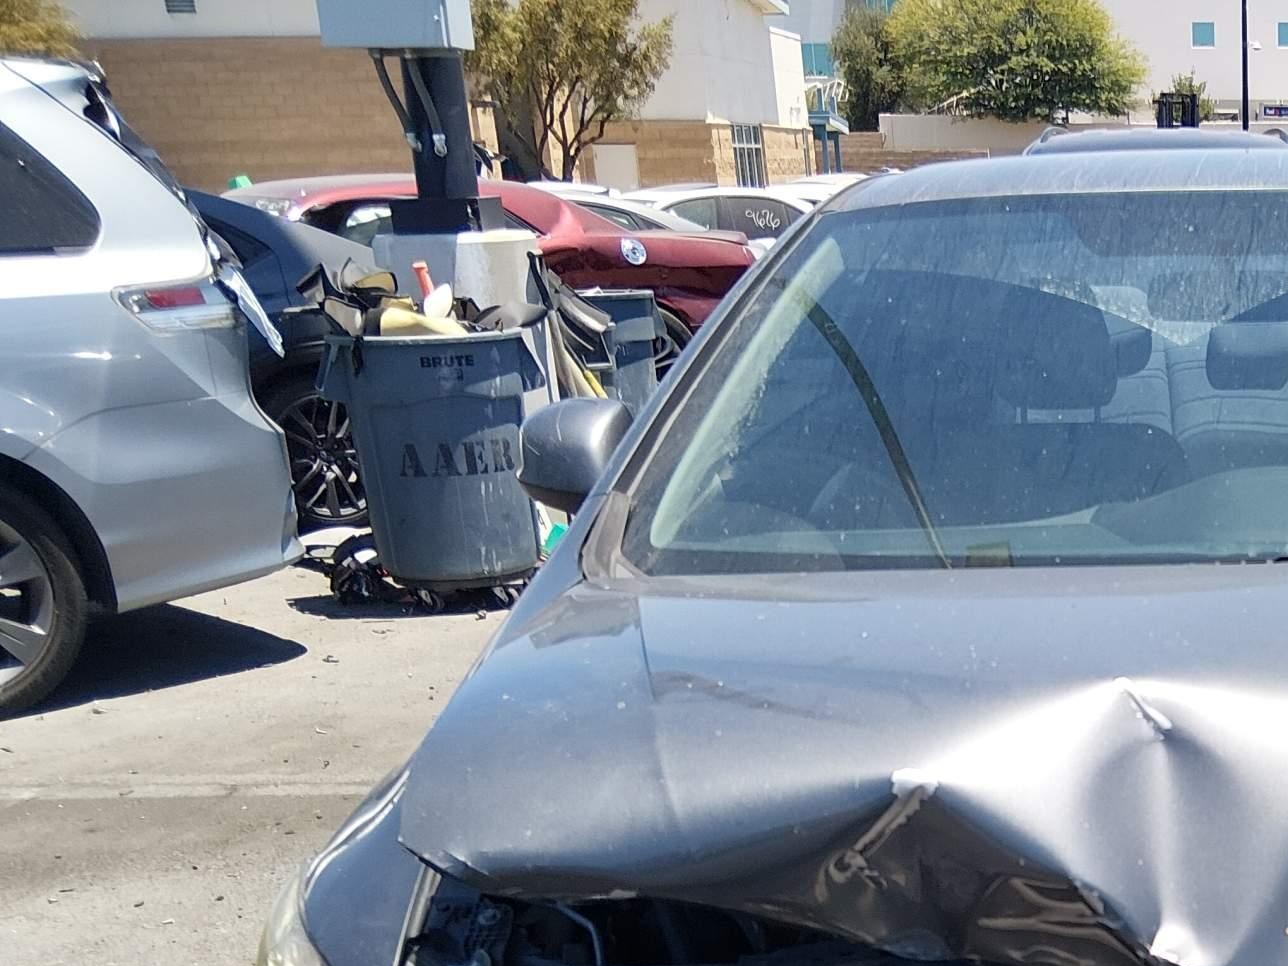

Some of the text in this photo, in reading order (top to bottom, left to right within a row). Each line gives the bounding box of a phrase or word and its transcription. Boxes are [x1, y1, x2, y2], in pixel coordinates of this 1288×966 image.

[744, 209, 781, 231] 9676
[420, 355, 475, 368] BRUTE
[400, 439, 515, 477] AAER
